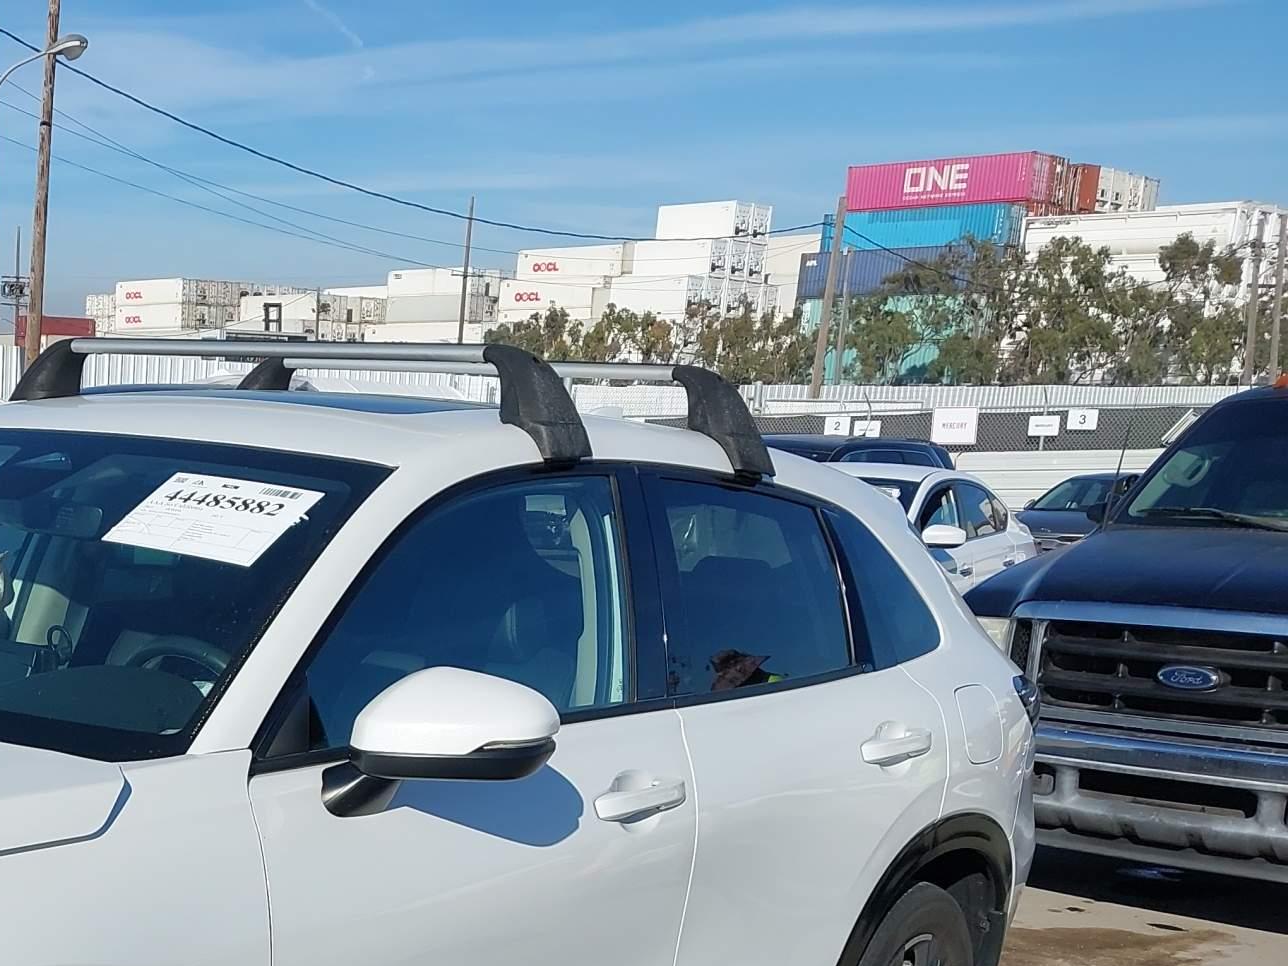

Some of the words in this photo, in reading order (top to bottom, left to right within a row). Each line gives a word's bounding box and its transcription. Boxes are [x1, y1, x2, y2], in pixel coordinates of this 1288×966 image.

[903, 163, 969, 193] ONE
[533, 262, 559, 272] OOCL
[125, 291, 143, 300] OOCL
[515, 292, 541, 302] OOCL
[125, 315, 142, 324] OOCL
[1078, 414, 1087, 425] 3
[833, 421, 841, 431] 2
[164, 489, 286, 517] 44485882
[1170, 671, 1203, 684] Ford
